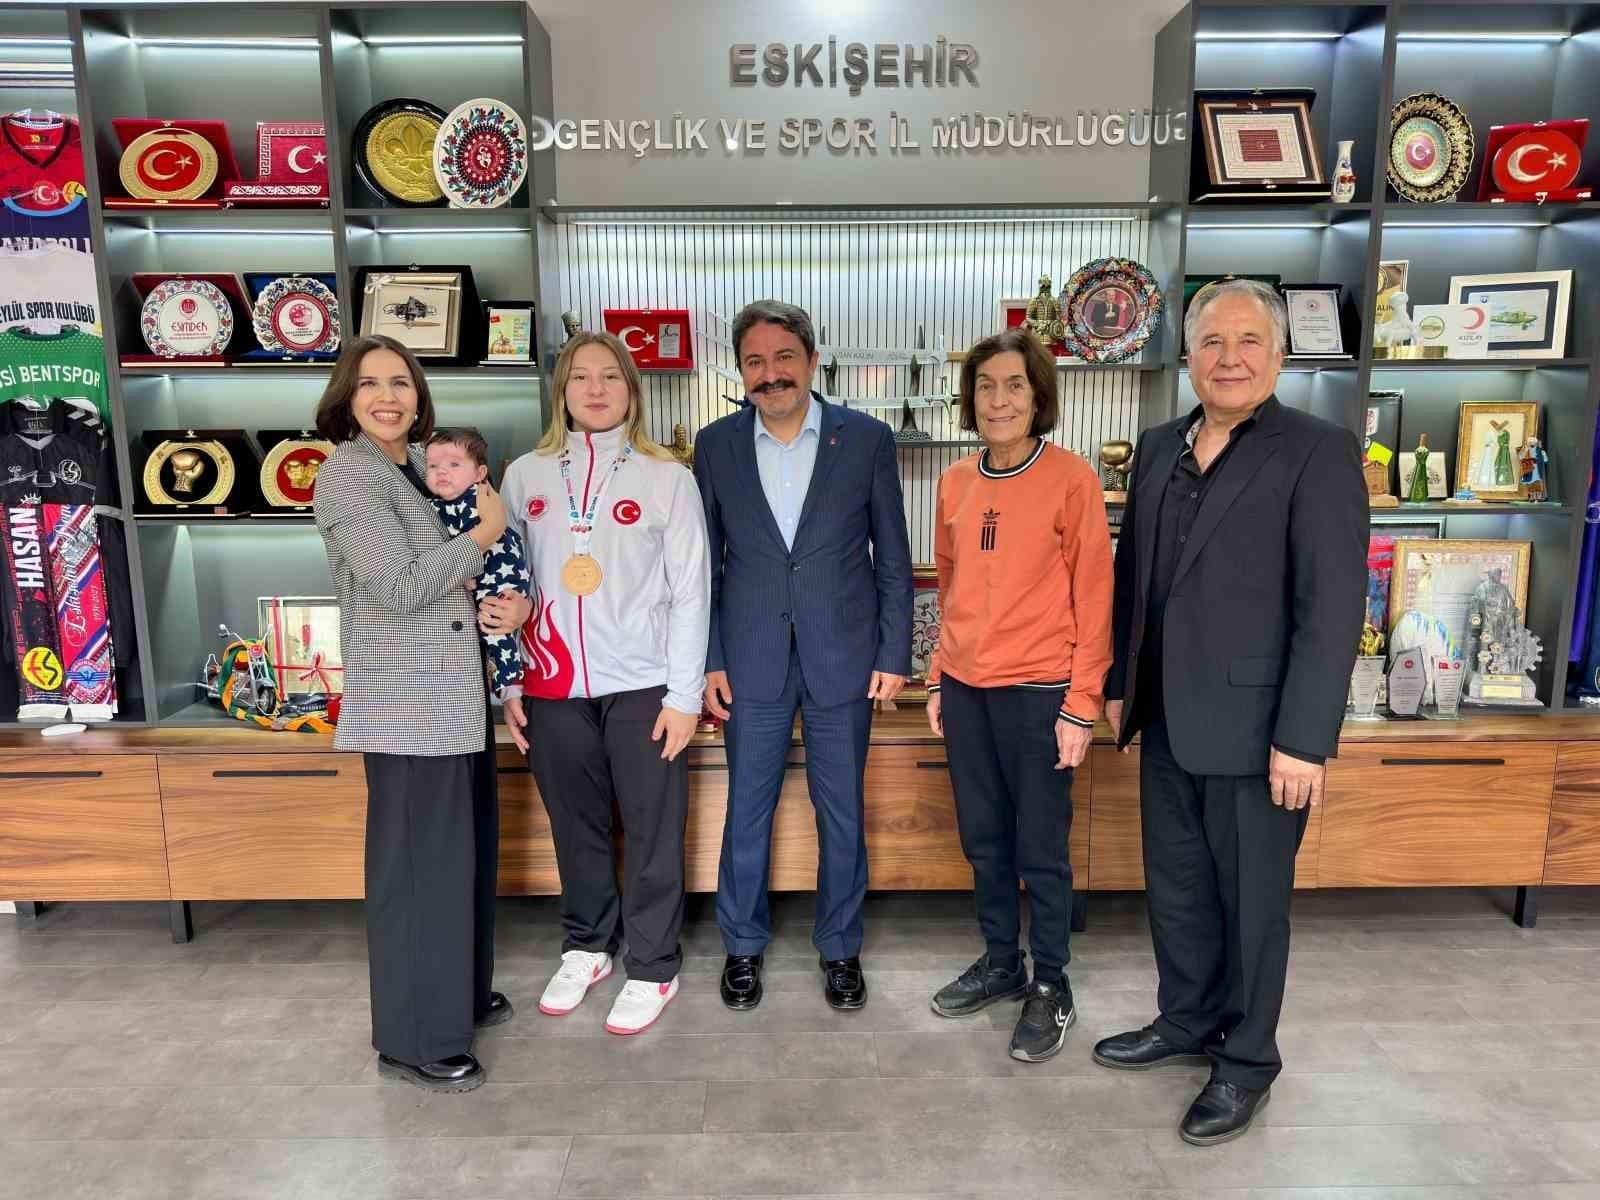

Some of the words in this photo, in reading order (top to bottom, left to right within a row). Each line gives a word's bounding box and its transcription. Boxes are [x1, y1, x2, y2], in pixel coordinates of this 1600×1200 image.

[729, 34, 980, 97] ESKİŞEHİR
[553, 111, 709, 159] GENÇLİK
[719, 119, 769, 151] VE
[778, 117, 877, 152] SPOR
[888, 111, 921, 150] İL
[931, 107, 1151, 149] MÜDÜRLÜĞÜ
[26, 301, 55, 320] SPOR
[55, 301, 96, 325] KULÜBÜ
[0, 364, 17, 389] Sİ
[19, 365, 100, 388] BENTSPOR
[8, 507, 45, 589] HASAN
